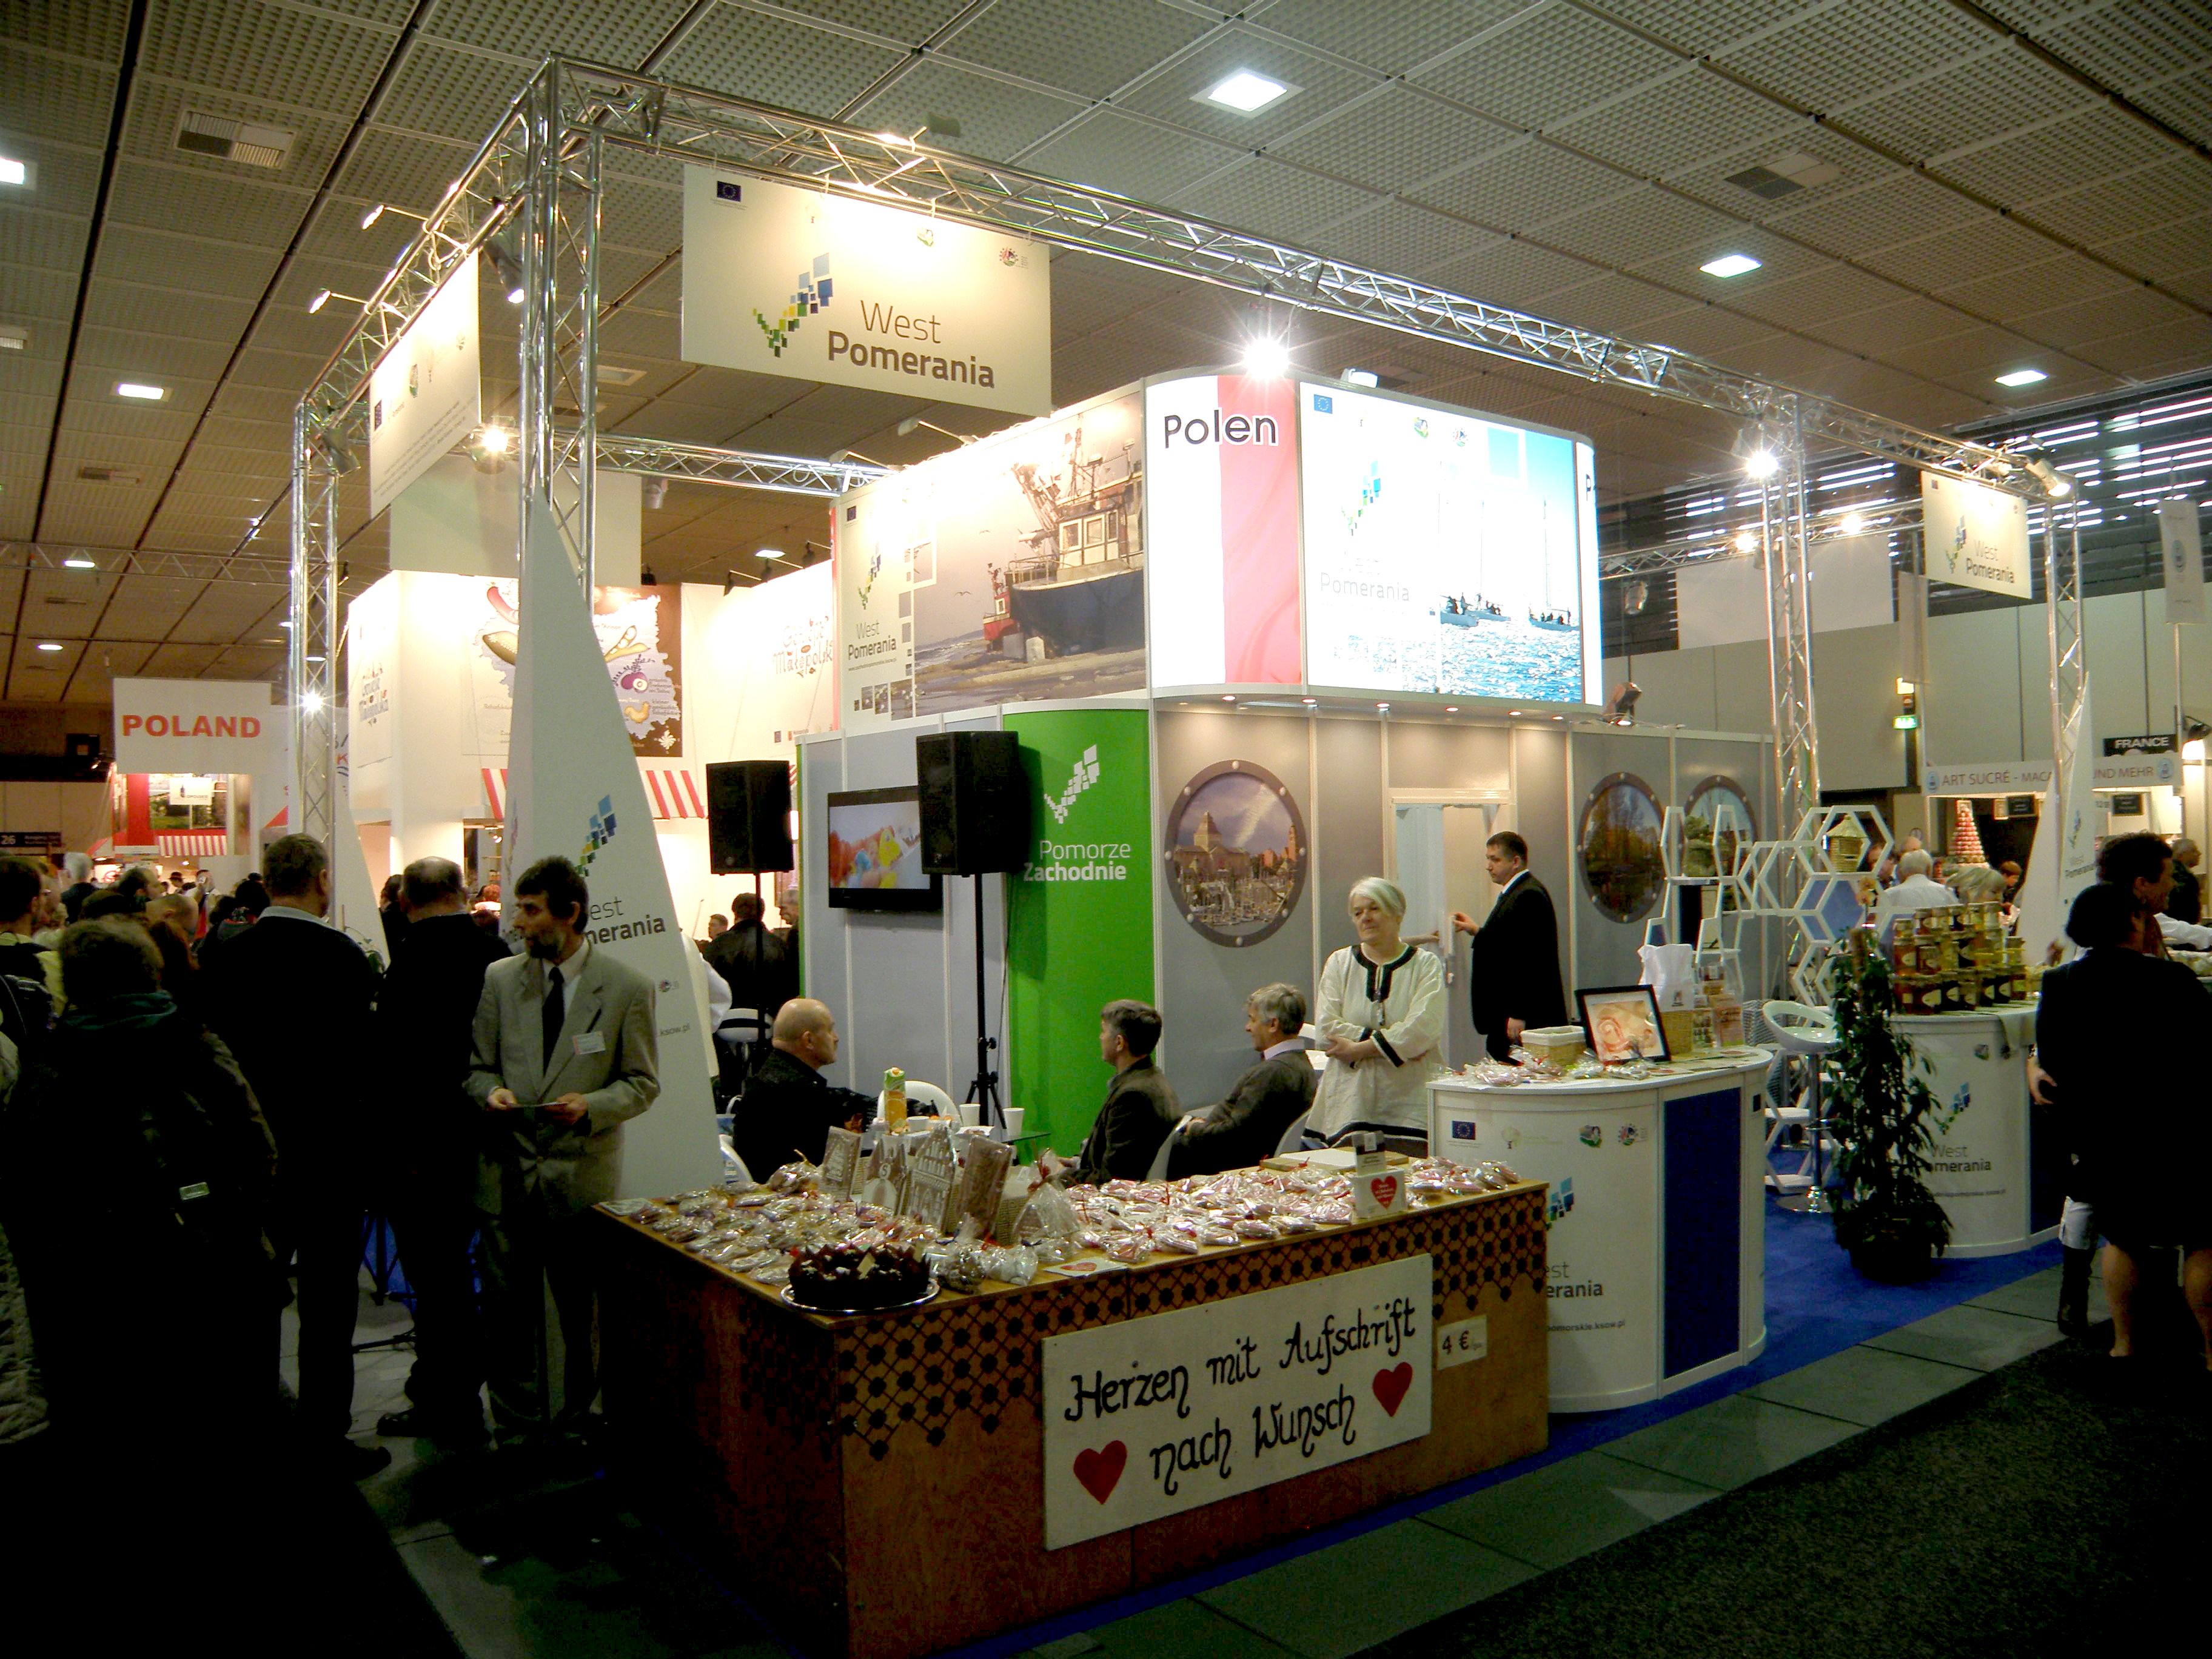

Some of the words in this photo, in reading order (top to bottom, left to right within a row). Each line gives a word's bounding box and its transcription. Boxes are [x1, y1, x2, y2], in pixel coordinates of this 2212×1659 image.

[860, 300, 941, 343] West
[828, 330, 994, 389] Pomerania
[1164, 409, 1278, 449] Polen
[1974, 540, 1998, 561] West
[1966, 557, 2014, 583] Pomerania
[1321, 572, 1410, 602] Pomerania
[856, 620, 879, 639] West
[848, 635, 897, 660] Pomerania
[122, 714, 261, 739] POLAND
[2114, 737, 2170, 749] FRANCE
[1942, 773, 1966, 786] ART
[1969, 769, 2010, 785] SUCRÉ
[2119, 766, 2154, 778] MEHR
[1039, 839, 1131, 860] Pomorze
[1023, 861, 1127, 882] Zachodnie
[590, 896, 624, 920] est
[1931, 1145, 1968, 1158] West
[1934, 1159, 1992, 1172] merania
[1547, 1279, 1604, 1298] erania
[1442, 1335, 1452, 1355] 4
[1459, 1329, 1470, 1350] €
[1064, 1366, 1190, 1423] Herzen
[1206, 1336, 1261, 1386] mit
[1279, 1298, 1416, 1375] Aufschrift
[1149, 1417, 1232, 1496] nach
[1253, 1384, 1356, 1458] Wunsch
